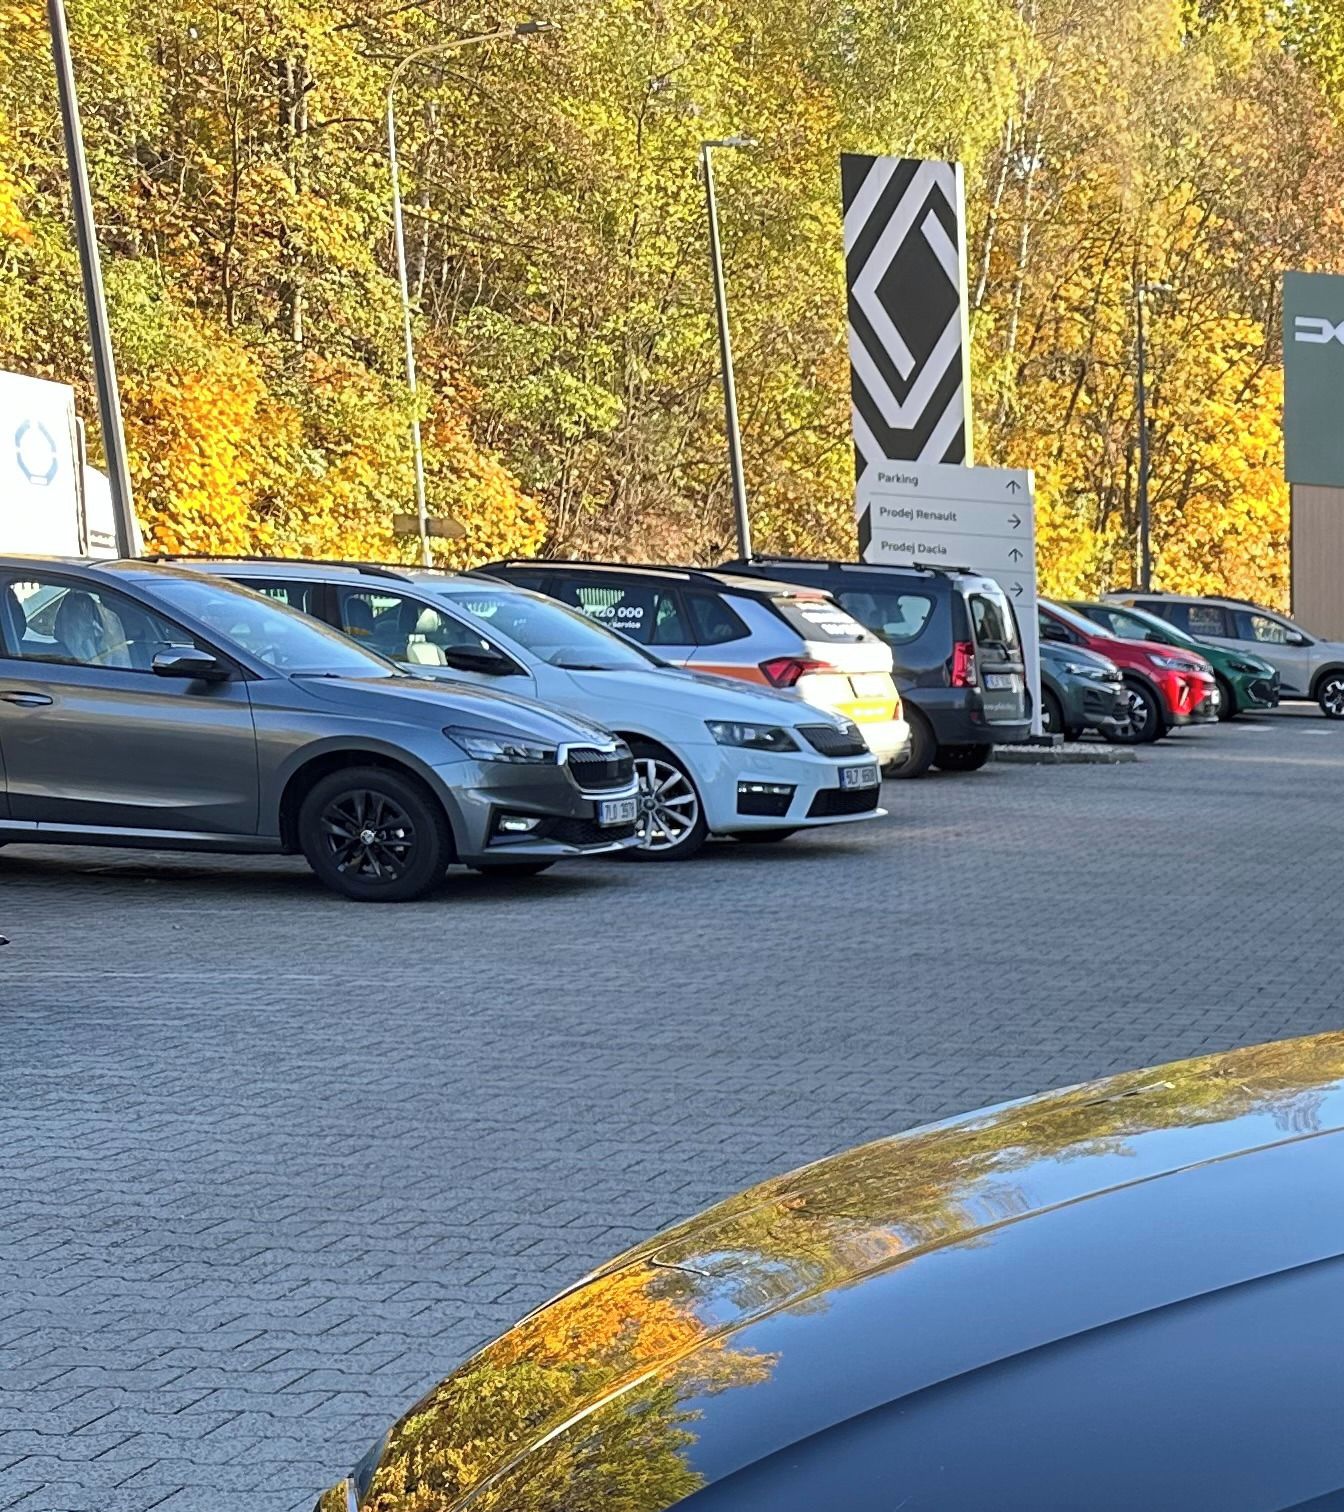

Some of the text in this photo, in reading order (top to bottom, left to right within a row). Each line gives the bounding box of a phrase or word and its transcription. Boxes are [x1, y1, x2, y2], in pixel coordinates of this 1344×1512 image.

[877, 472, 919, 487] Parking
[879, 507, 957, 522] Prodej Renault
[881, 541, 947, 555] Prodej Dacia
[617, 606, 644, 618] 000
